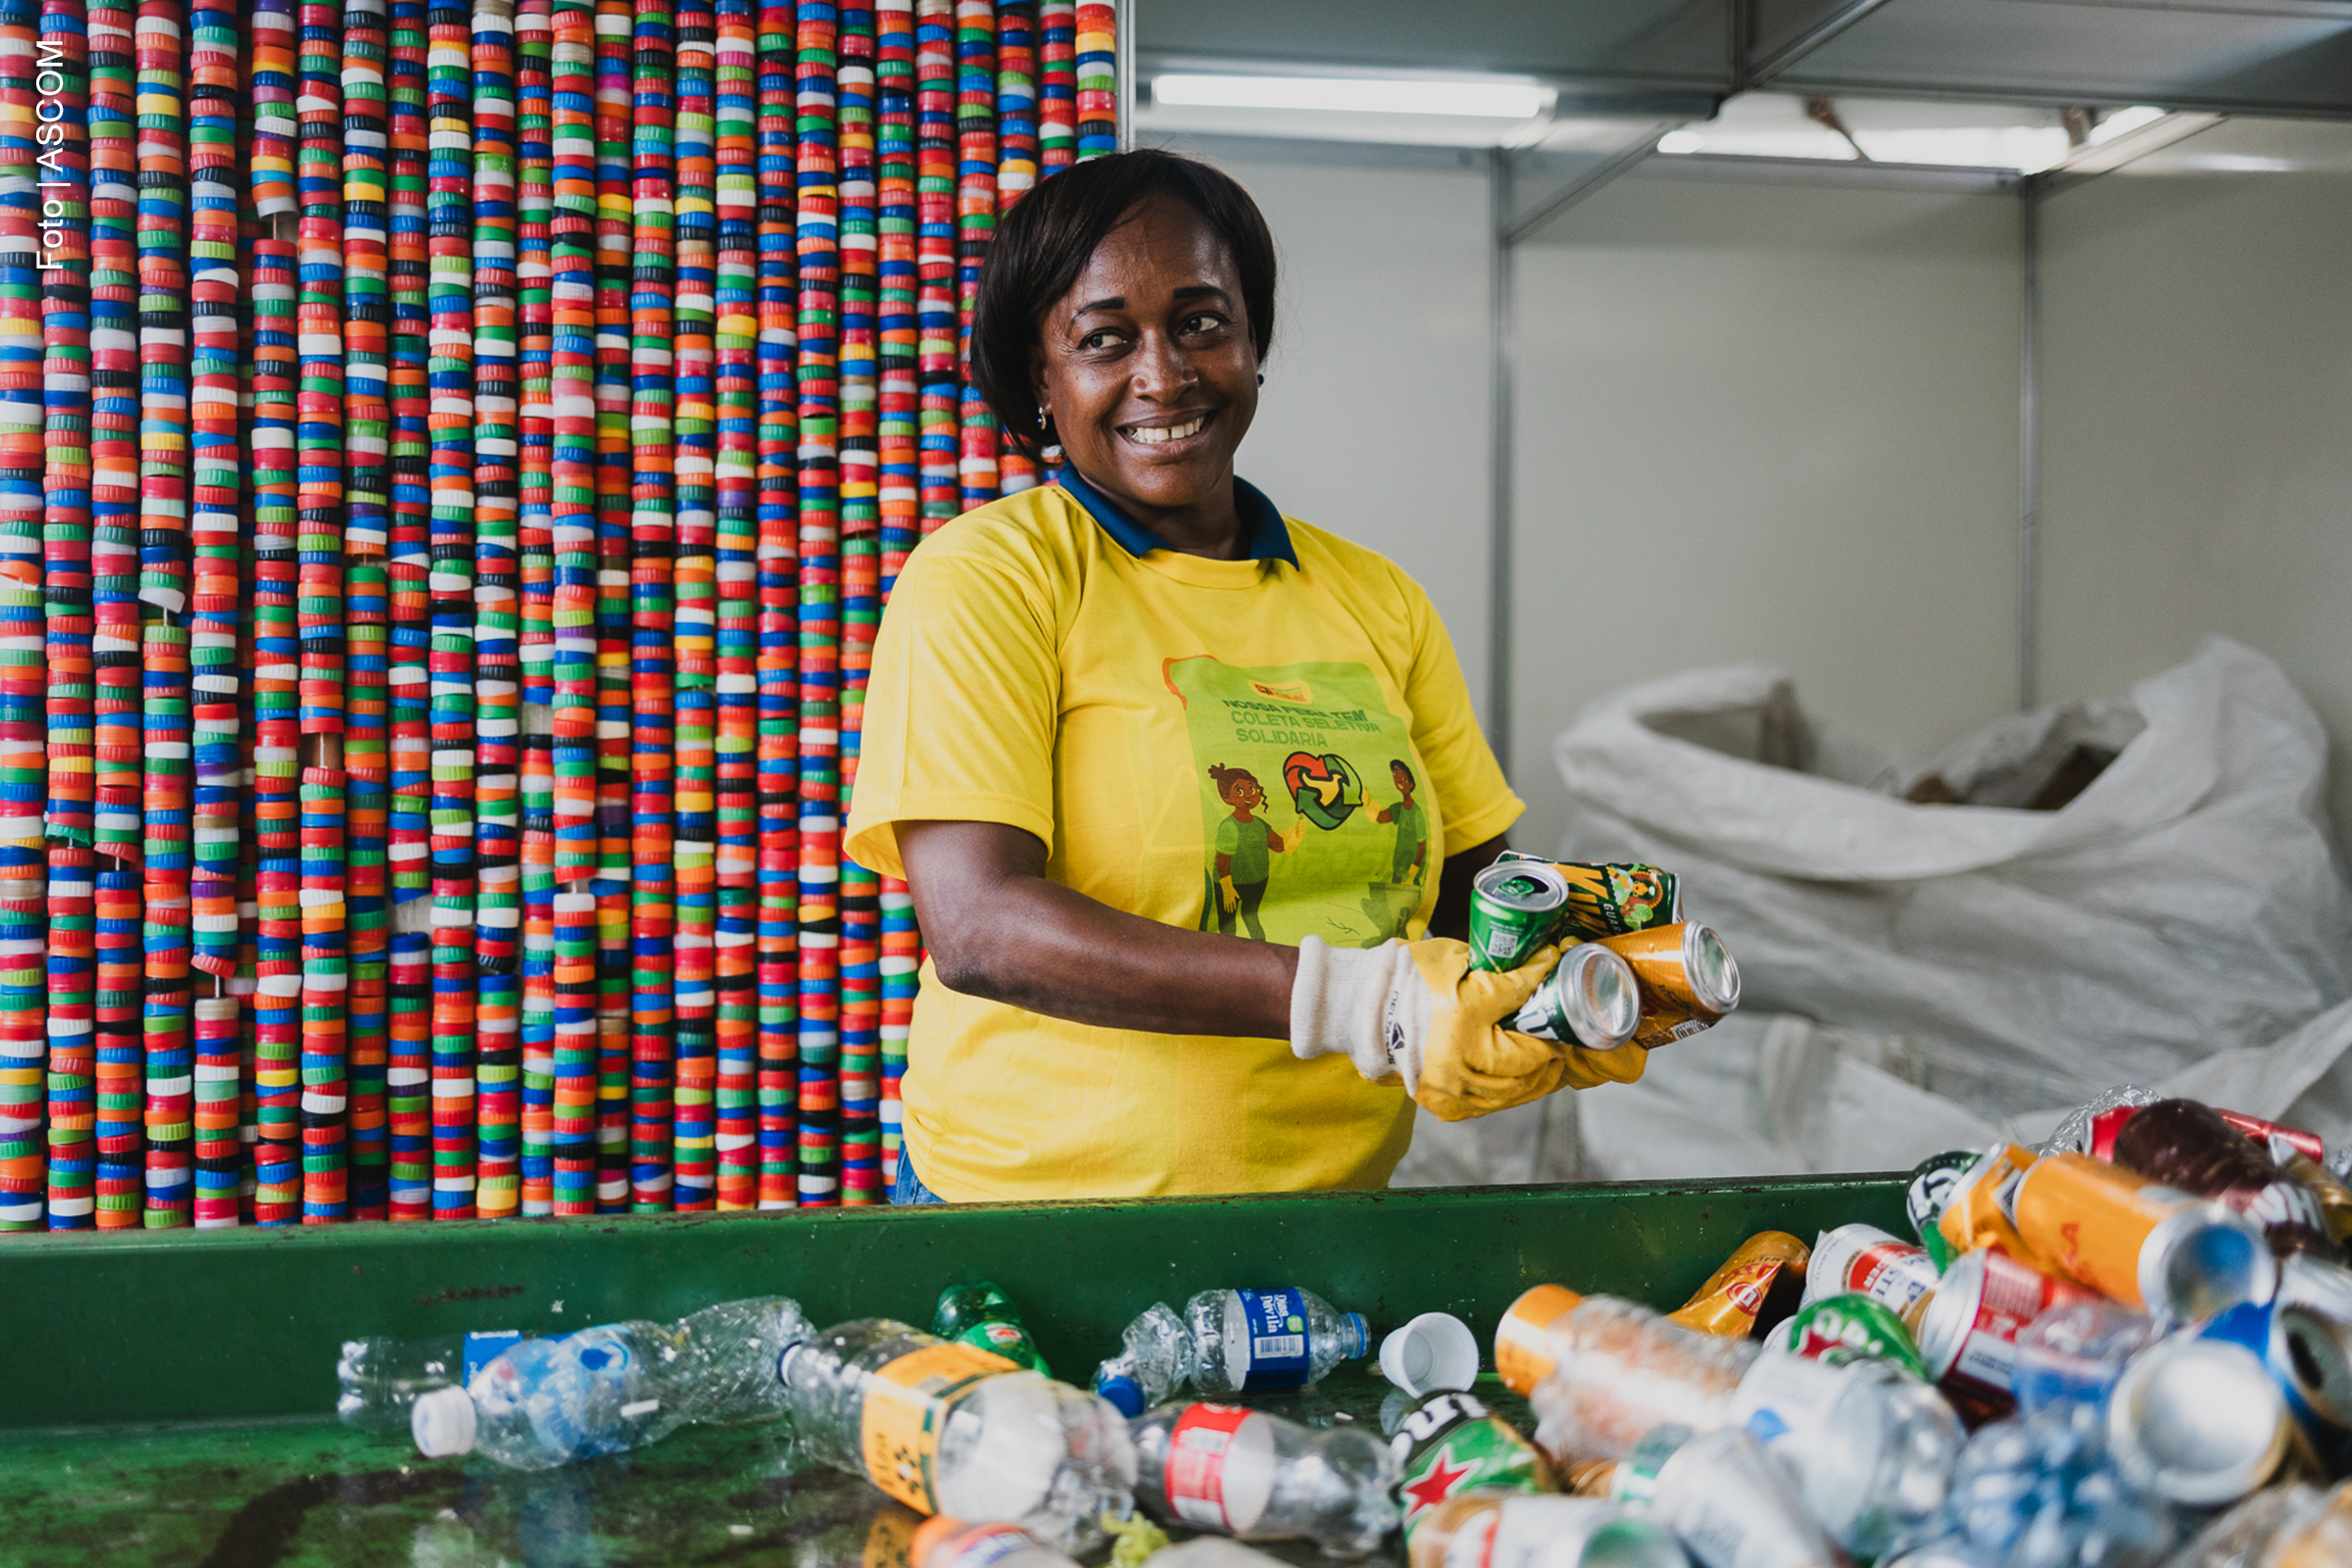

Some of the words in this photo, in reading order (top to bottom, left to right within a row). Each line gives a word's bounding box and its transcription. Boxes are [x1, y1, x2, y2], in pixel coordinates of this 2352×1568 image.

[1221, 699, 1282, 713] NOSSA
[1330, 710, 1368, 722] TEM
[1231, 710, 1301, 728] COLETA
[1301, 716, 1383, 733] SELETIVA
